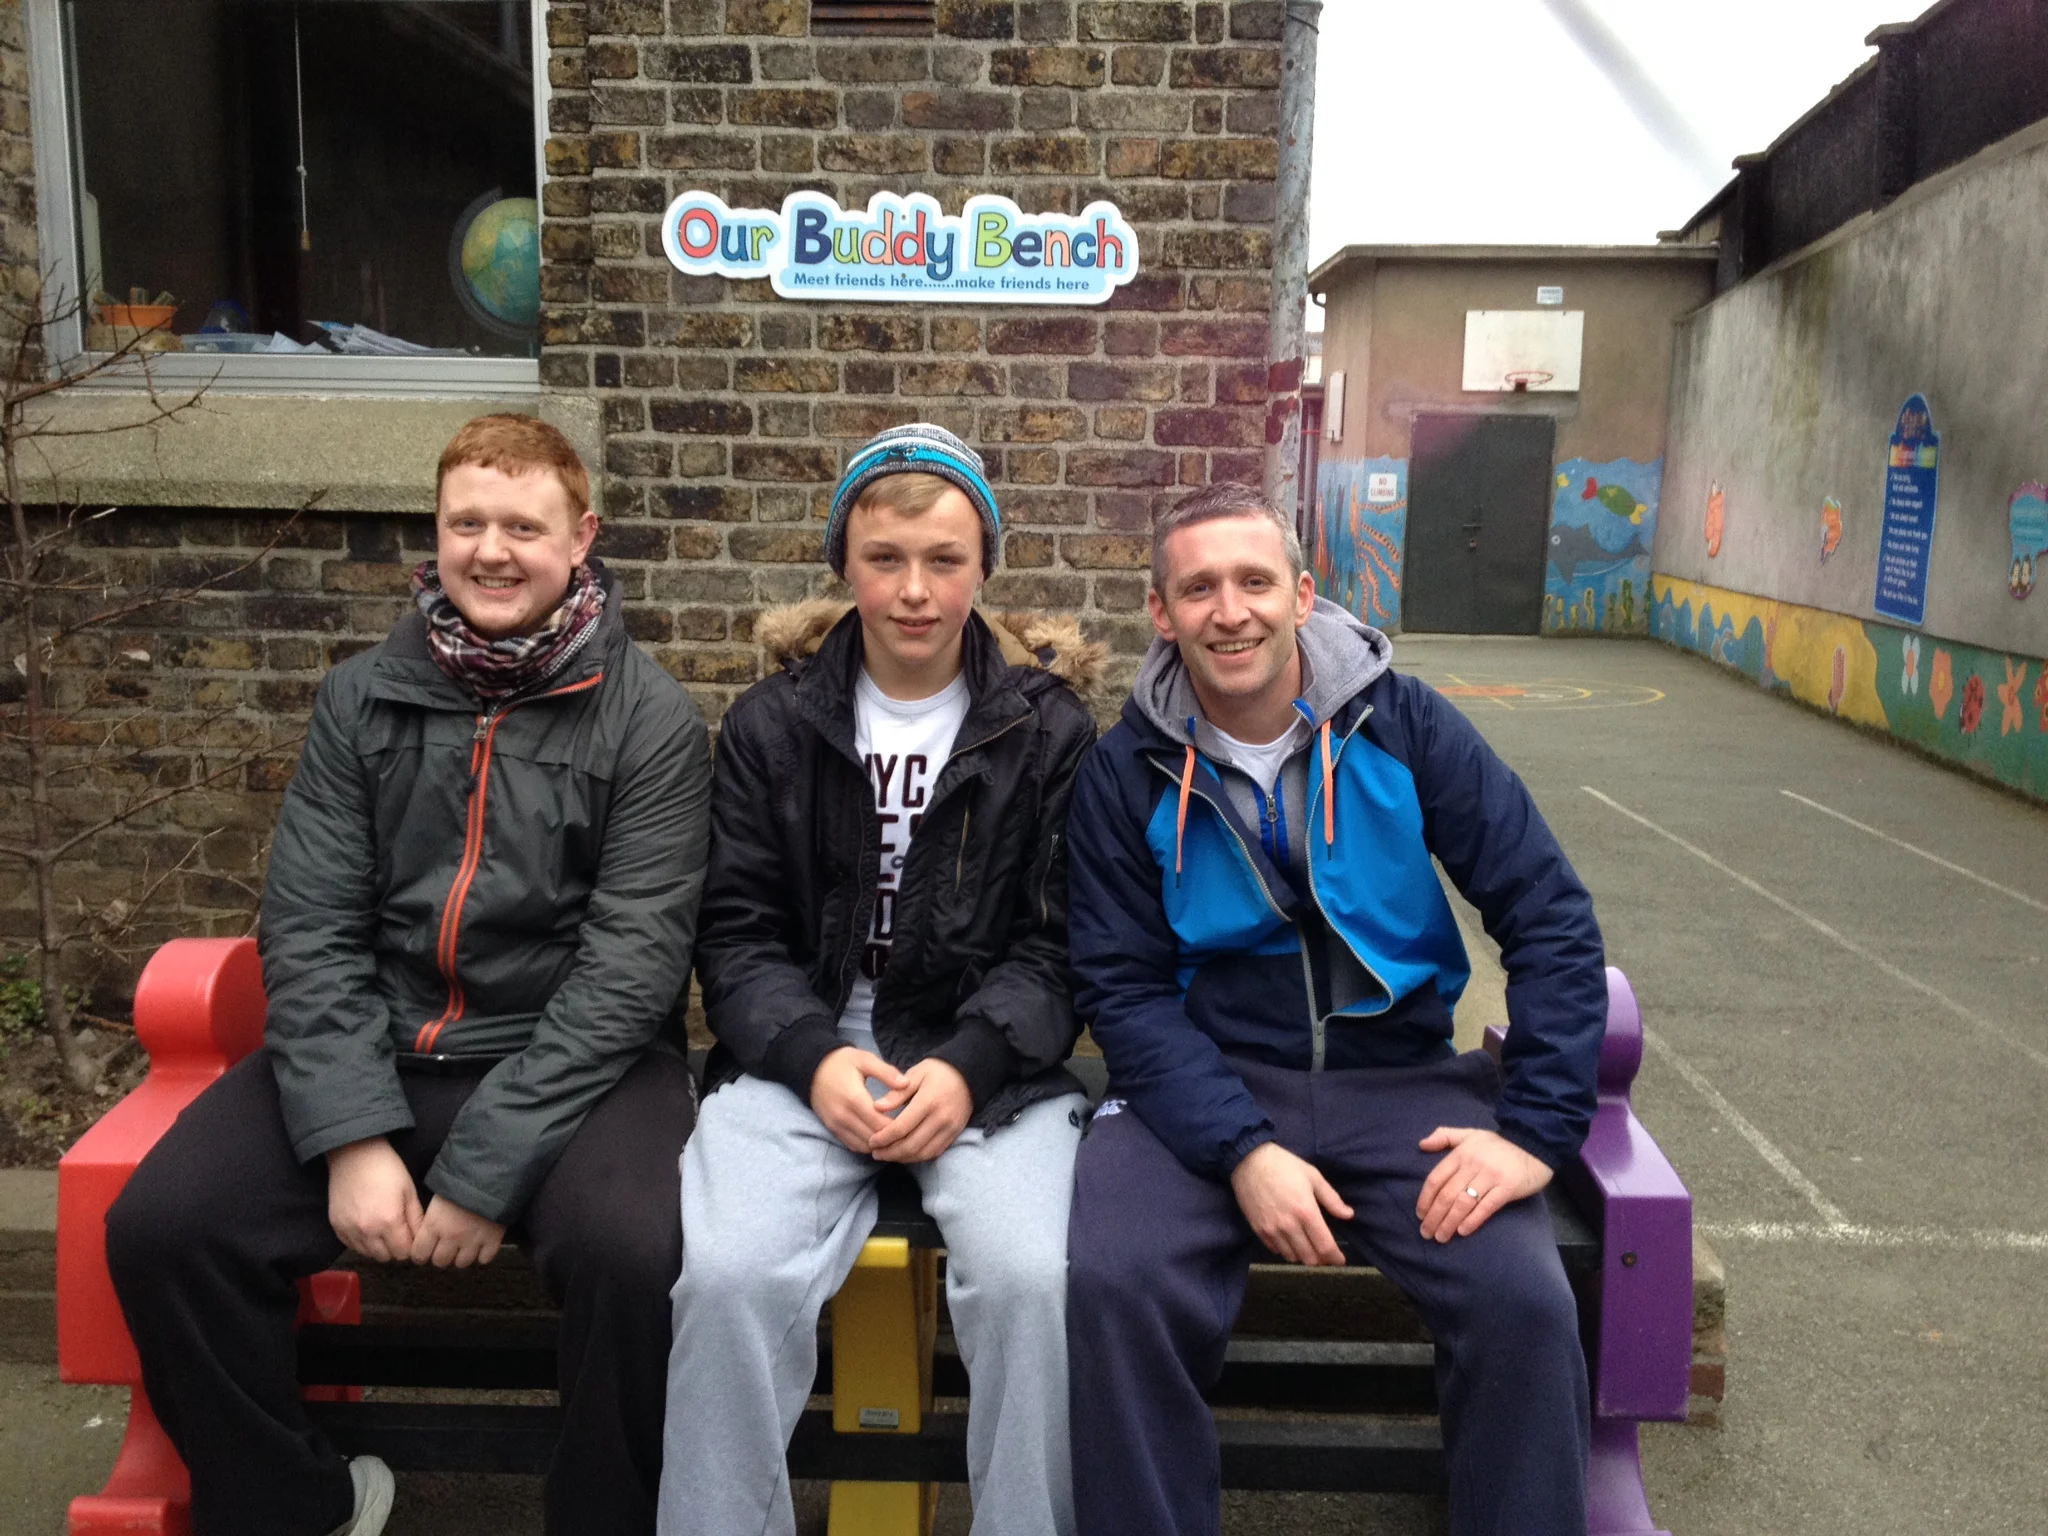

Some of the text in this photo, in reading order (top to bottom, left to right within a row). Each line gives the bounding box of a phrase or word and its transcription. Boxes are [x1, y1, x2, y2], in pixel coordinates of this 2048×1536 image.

[678, 207, 1123, 281] Our Buddy Bench
[794, 272, 830, 286] Meet
[835, 273, 886, 288] friends
[1000, 276, 1052, 291] friends
[1056, 276, 1090, 291] here
[864, 753, 927, 808] YC
